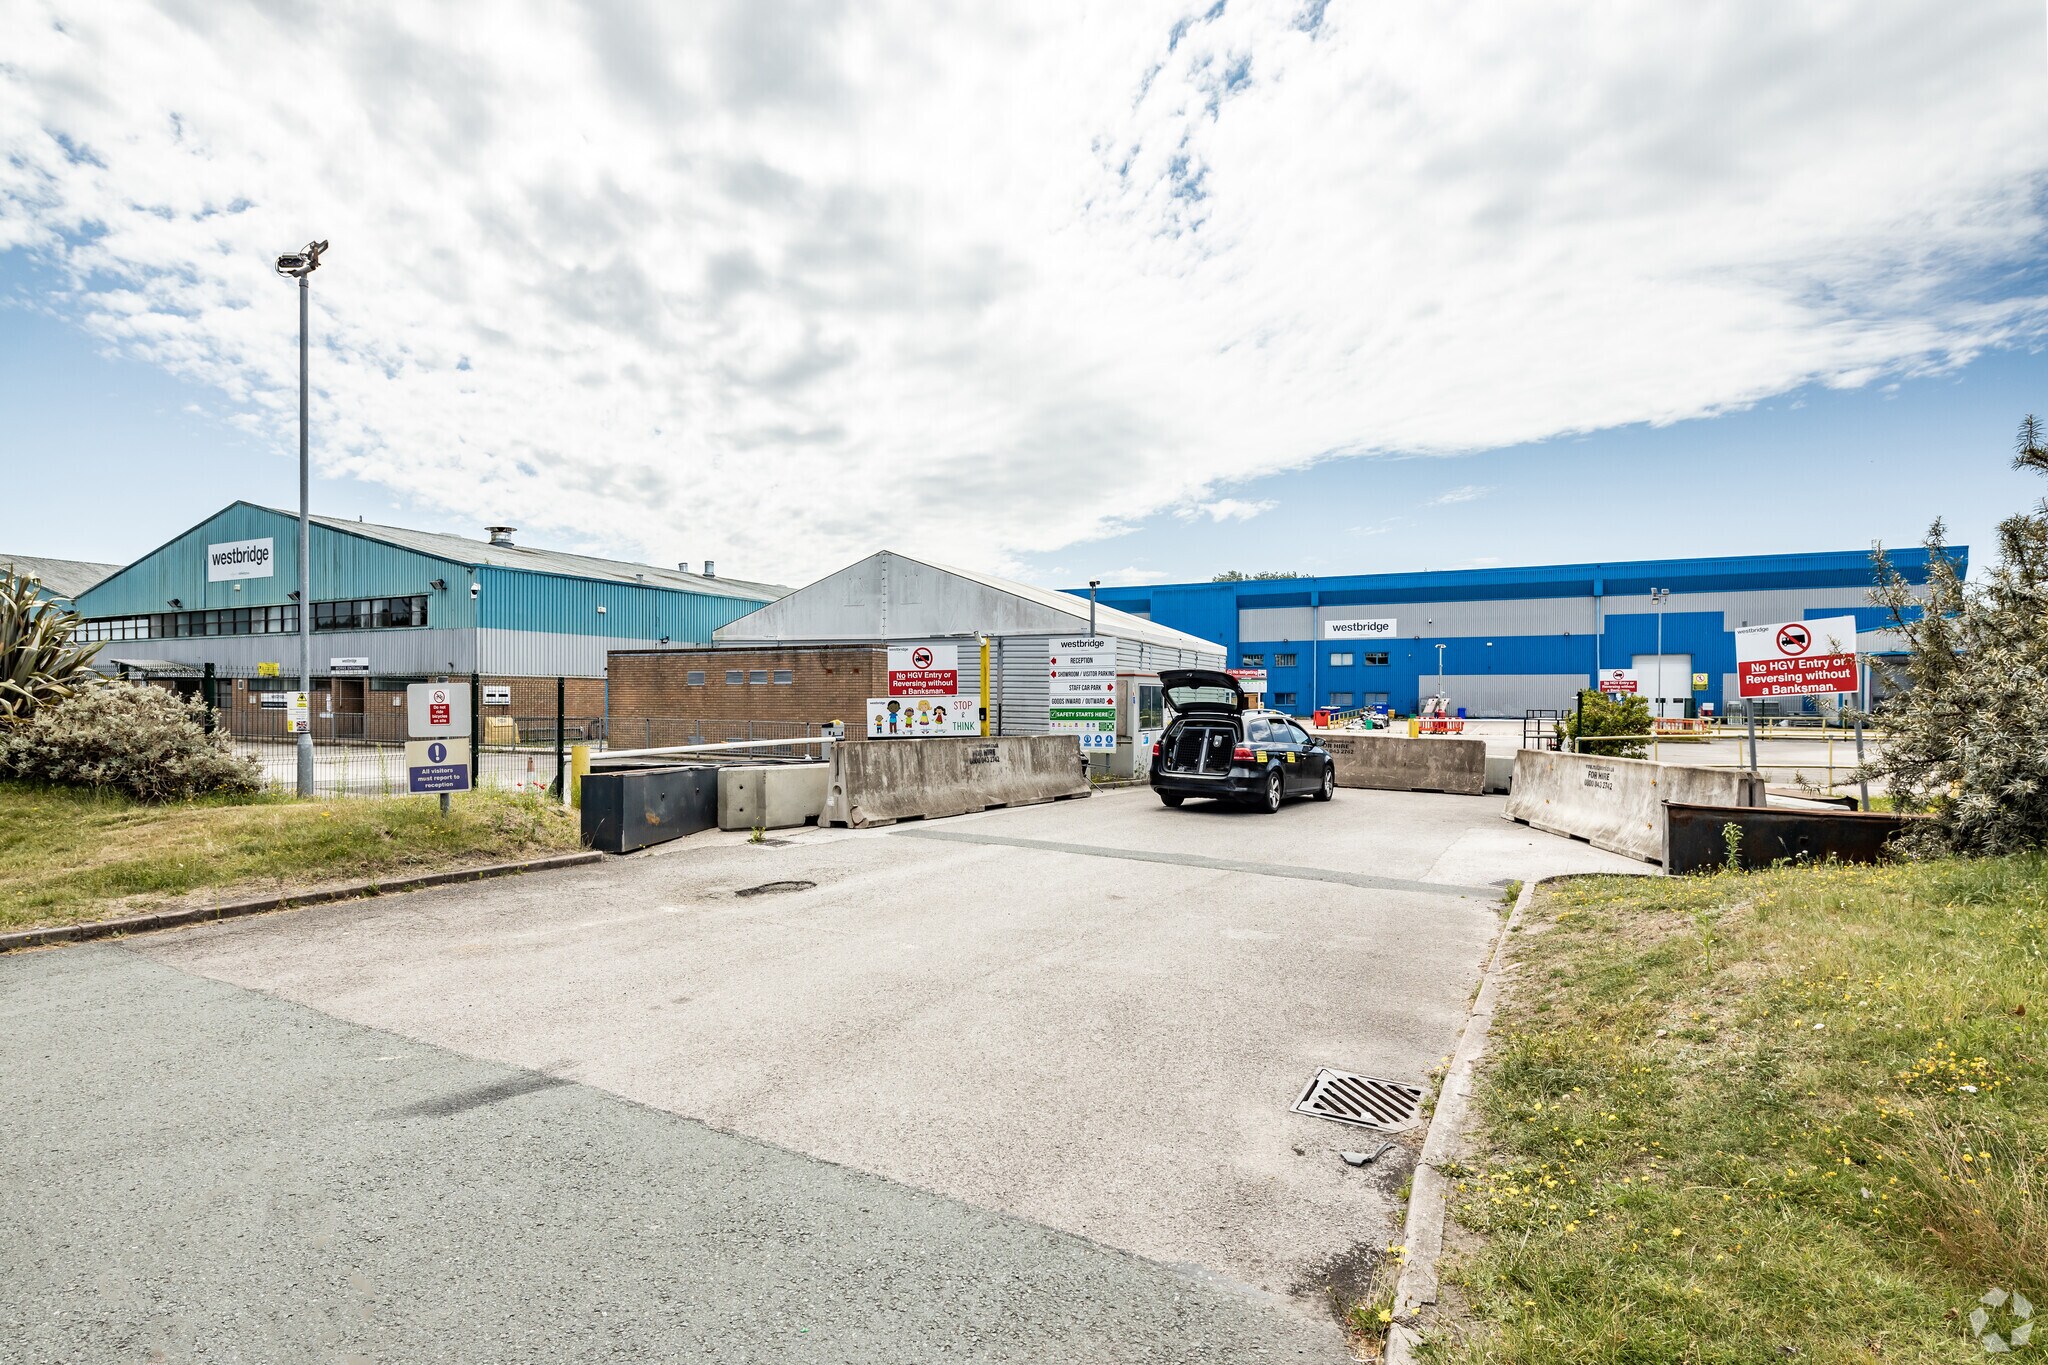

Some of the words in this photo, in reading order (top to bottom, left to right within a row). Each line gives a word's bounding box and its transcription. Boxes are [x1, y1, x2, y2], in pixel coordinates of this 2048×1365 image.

[212, 545, 269, 565] westbridge
[1332, 622, 1389, 632] westbridge
[1737, 626, 1769, 634] westbridge
[1061, 639, 1104, 648] westbridge
[1751, 663, 1766, 673] No
[1770, 661, 1795, 671] HGV
[1799, 658, 1829, 668] Entry
[1833, 658, 1845, 666] or
[896, 672, 906, 680] No
[925, 671, 942, 679] Entry
[1746, 673, 1802, 684] Reversing
[1806, 669, 1850, 680] without
[893, 680, 926, 688] Reversing
[908, 687, 946, 695] Banksman.
[1762, 687, 1769, 695] a
[1772, 683, 1837, 694] Banksman.
[954, 701, 972, 710] STOP
[953, 721, 975, 731] THINK
[433, 774, 453, 782] report
[1588, 770, 1598, 779] FOR
[1598, 772, 1610, 780] HIRE
[425, 781, 454, 789] reception
